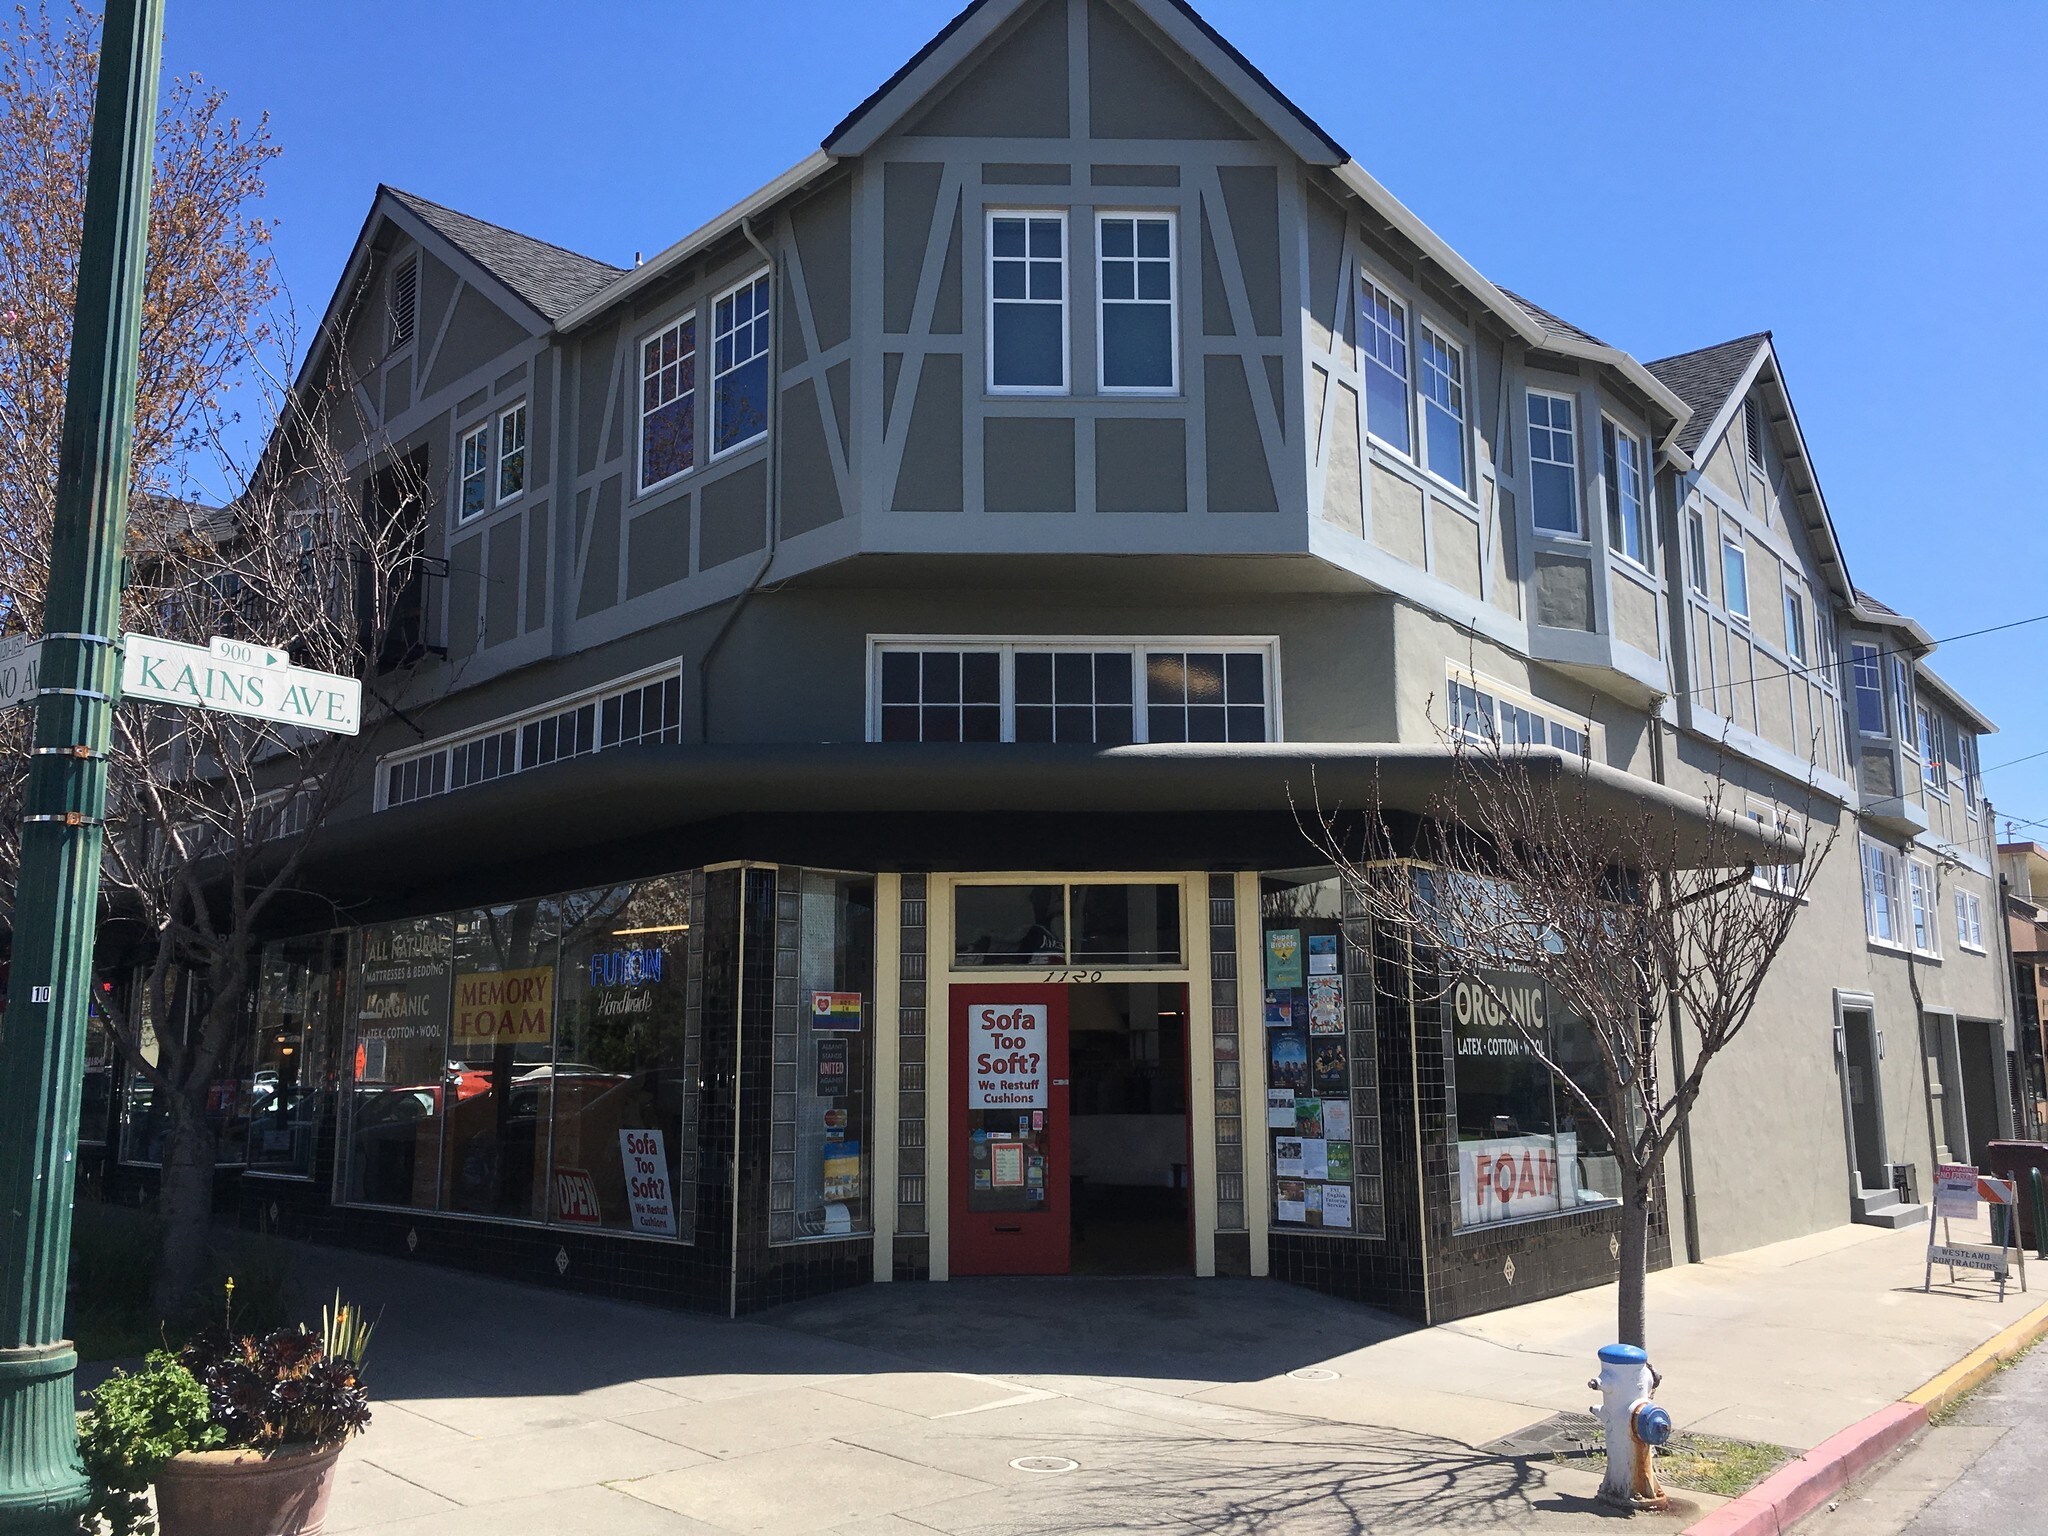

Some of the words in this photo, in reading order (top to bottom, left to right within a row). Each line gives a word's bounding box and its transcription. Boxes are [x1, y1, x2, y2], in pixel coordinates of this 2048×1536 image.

[220, 643, 252, 663] 900
[137, 656, 264, 707] KAINS
[279, 685, 352, 725] AVE.
[368, 941, 388, 961] ALL
[366, 967, 405, 982] MATTRESSES
[413, 963, 445, 978] BEDDING
[591, 947, 663, 987] FUTON
[1043, 970, 1102, 983] 1120
[34, 986, 50, 1002] 10
[461, 976, 548, 1007] MEMORY
[375, 993, 430, 1018] ORGANIC
[1455, 981, 1544, 1029] ORGANIC
[460, 1008, 546, 1037] FOAM
[981, 1009, 1036, 1031] Sofa
[387, 1026, 415, 1039] COTTON
[420, 1025, 441, 1037] WOOL
[990, 1033, 1026, 1049] Too
[1457, 1037, 1482, 1055] LATEX
[1487, 1038, 1519, 1056] COTTON
[820, 1062, 844, 1075] UNITED
[977, 1053, 1041, 1075] Soft?
[978, 1081, 996, 1090] We
[1000, 1080, 1040, 1090] Restuff
[984, 1093, 1034, 1103] Cushions
[627, 1133, 657, 1156] Sofa
[635, 1157, 655, 1174] Too
[558, 1174, 599, 1217] OPEN
[631, 1176, 665, 1200] Soft?
[635, 1203, 646, 1213] We
[647, 1204, 668, 1215] Restuff
[640, 1216, 668, 1228] Cushions
[1932, 1256, 1999, 1271] CONTRACTORS
[1942, 1248, 1990, 1261] WESTLAND
